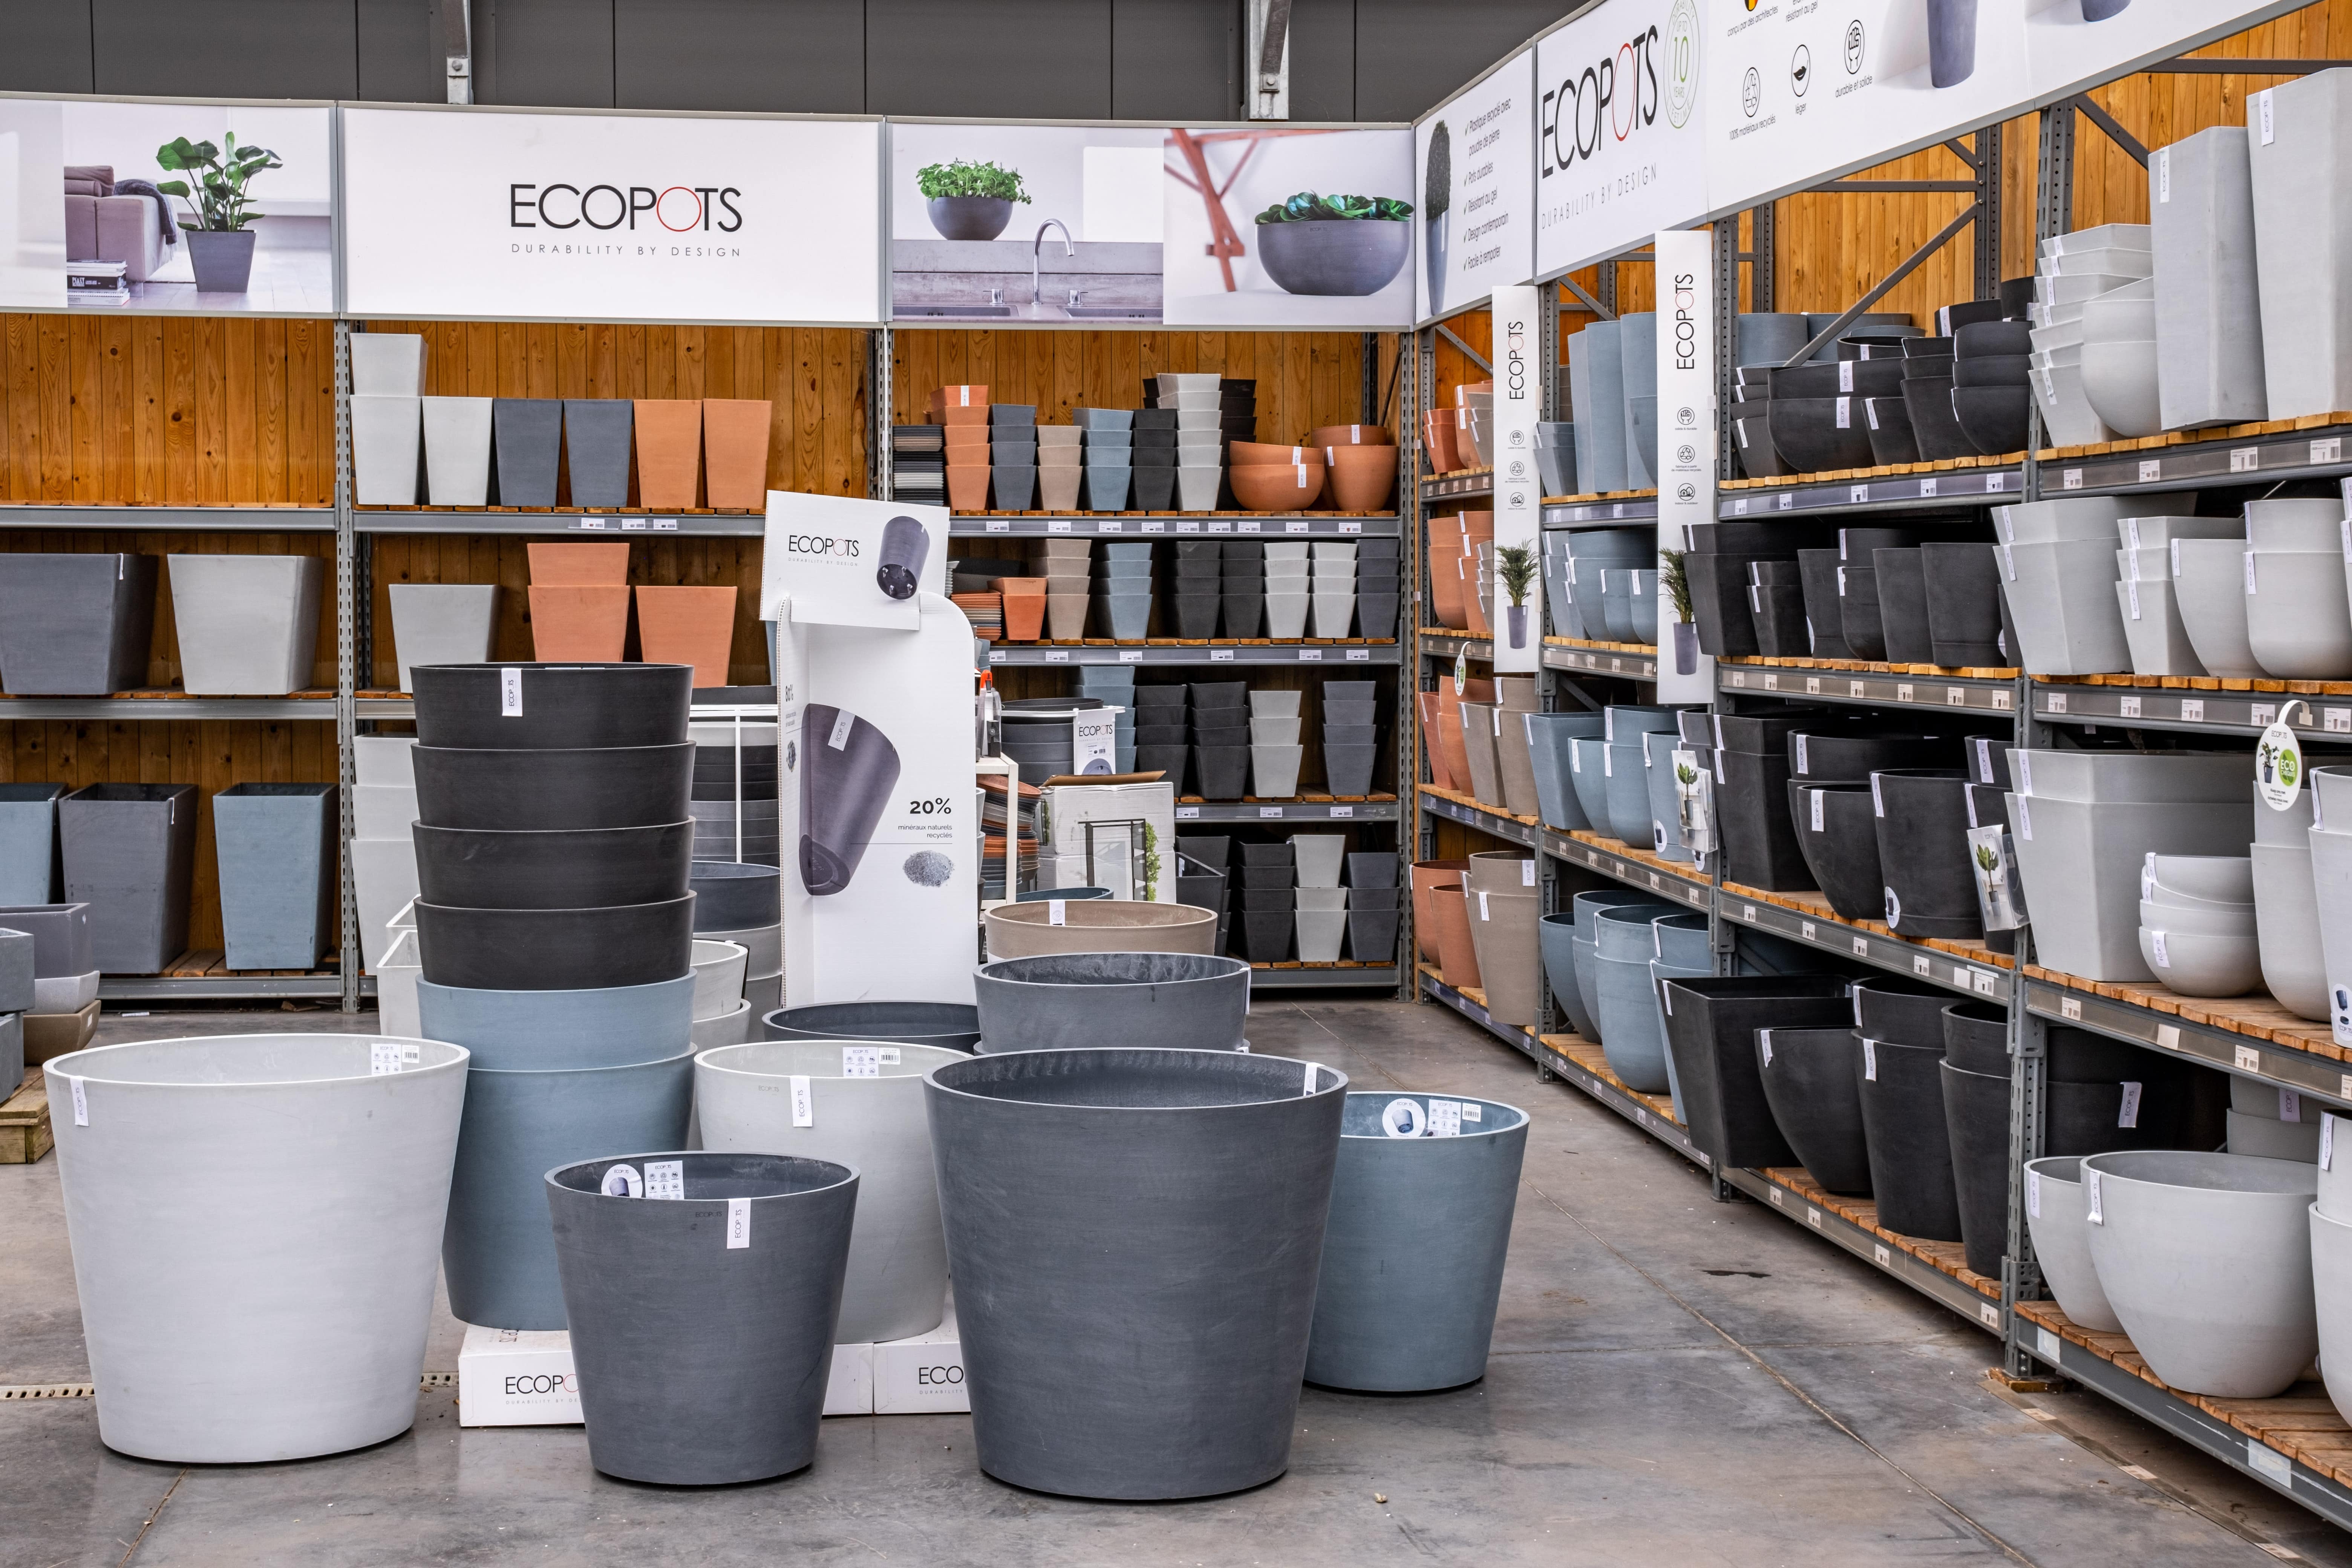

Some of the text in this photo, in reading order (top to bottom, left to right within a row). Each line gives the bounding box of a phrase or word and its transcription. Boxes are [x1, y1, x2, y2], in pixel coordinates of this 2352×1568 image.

[1727, 26, 1740, 37] conçu
[1755, 6, 1778, 23] architectes
[1786, 6, 1803, 23] résistant
[1804, 4, 1810, 14] au
[1674, 36, 1689, 83] 10
[1674, 87, 1684, 98] YEARS
[1835, 75, 1873, 98] durable et solide
[1542, 24, 1658, 180] ECOPOTS
[1667, 95, 1691, 123] LIFETIME
[1795, 102, 1807, 115] léger
[1469, 98, 1511, 134] Plastique recyclé avec
[1729, 113, 1776, 140] 100% matériaux recyclés
[1469, 129, 1500, 159] poudre de pierre
[1477, 160, 1493, 180] durables
[511, 184, 743, 232] ECOPOTS
[1468, 193, 1484, 213] Résistant
[1485, 193, 1490, 204] au
[1542, 162, 1658, 230] DURABILITY BY DESIGN
[1468, 211, 1508, 241] Design contemporain
[512, 244, 741, 257] DURABILITY BY DESIGN
[1468, 245, 1501, 270] Facile à rempoter
[1675, 273, 1695, 369] ECOPOTS
[1508, 321, 1524, 400] ECOPOTS
[789, 535, 859, 557] ECOPOTS
[786, 684, 794, 703] 80%
[1079, 724, 1113, 737] ECOPOTS
[2281, 760, 2295, 772] ECO
[910, 798, 951, 814] 20%
[919, 1366, 966, 1384] ECO
